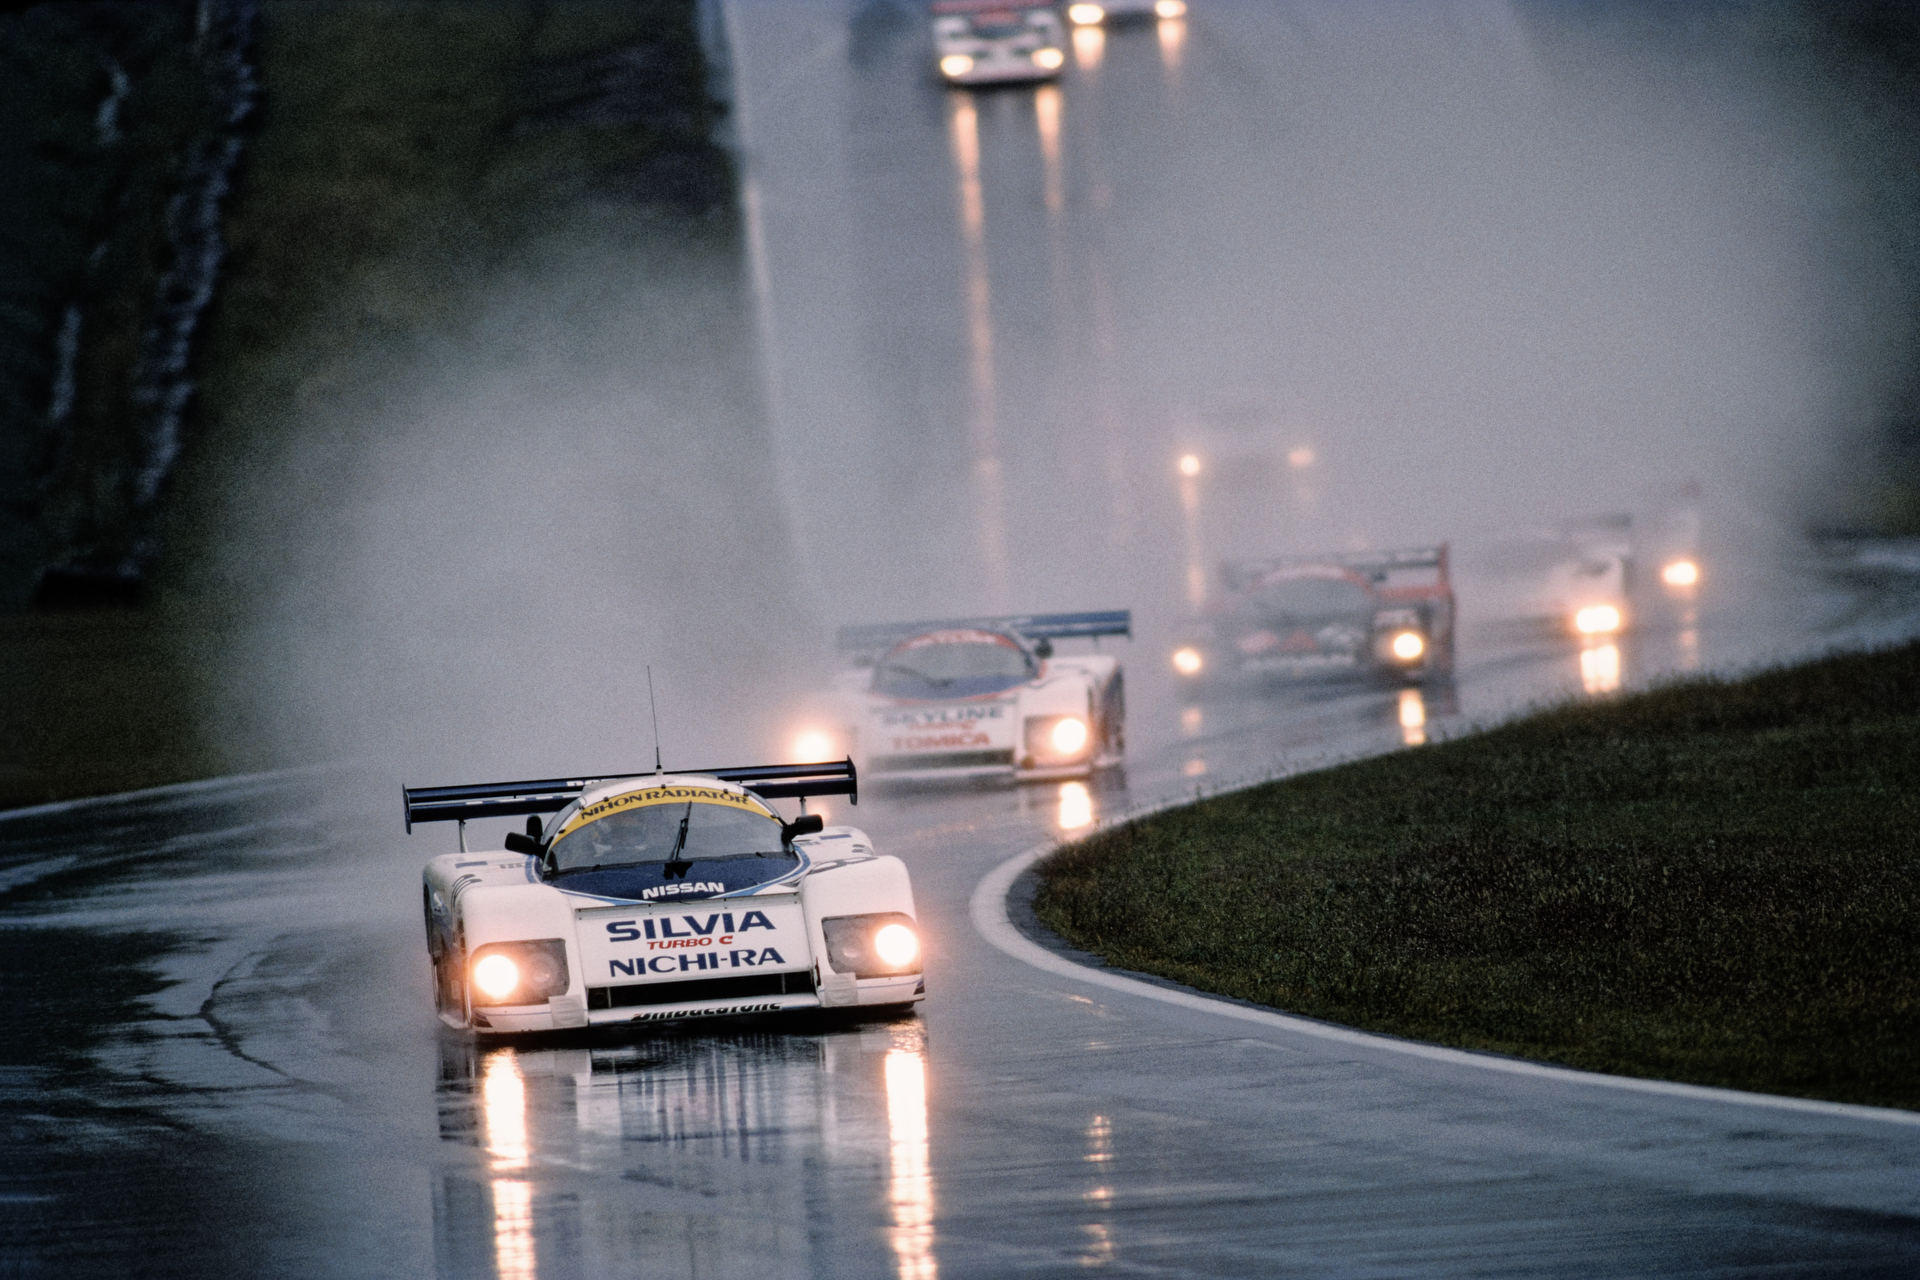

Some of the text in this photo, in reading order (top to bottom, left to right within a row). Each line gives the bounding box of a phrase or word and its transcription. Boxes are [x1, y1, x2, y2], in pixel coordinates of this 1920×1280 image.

[581, 789, 748, 820] NIHON RADIATOR
[642, 882, 725, 900] NISSAN
[606, 910, 777, 942] SILVIA
[647, 935, 734, 950] TURBO C
[609, 947, 786, 977] NICHI-RA
